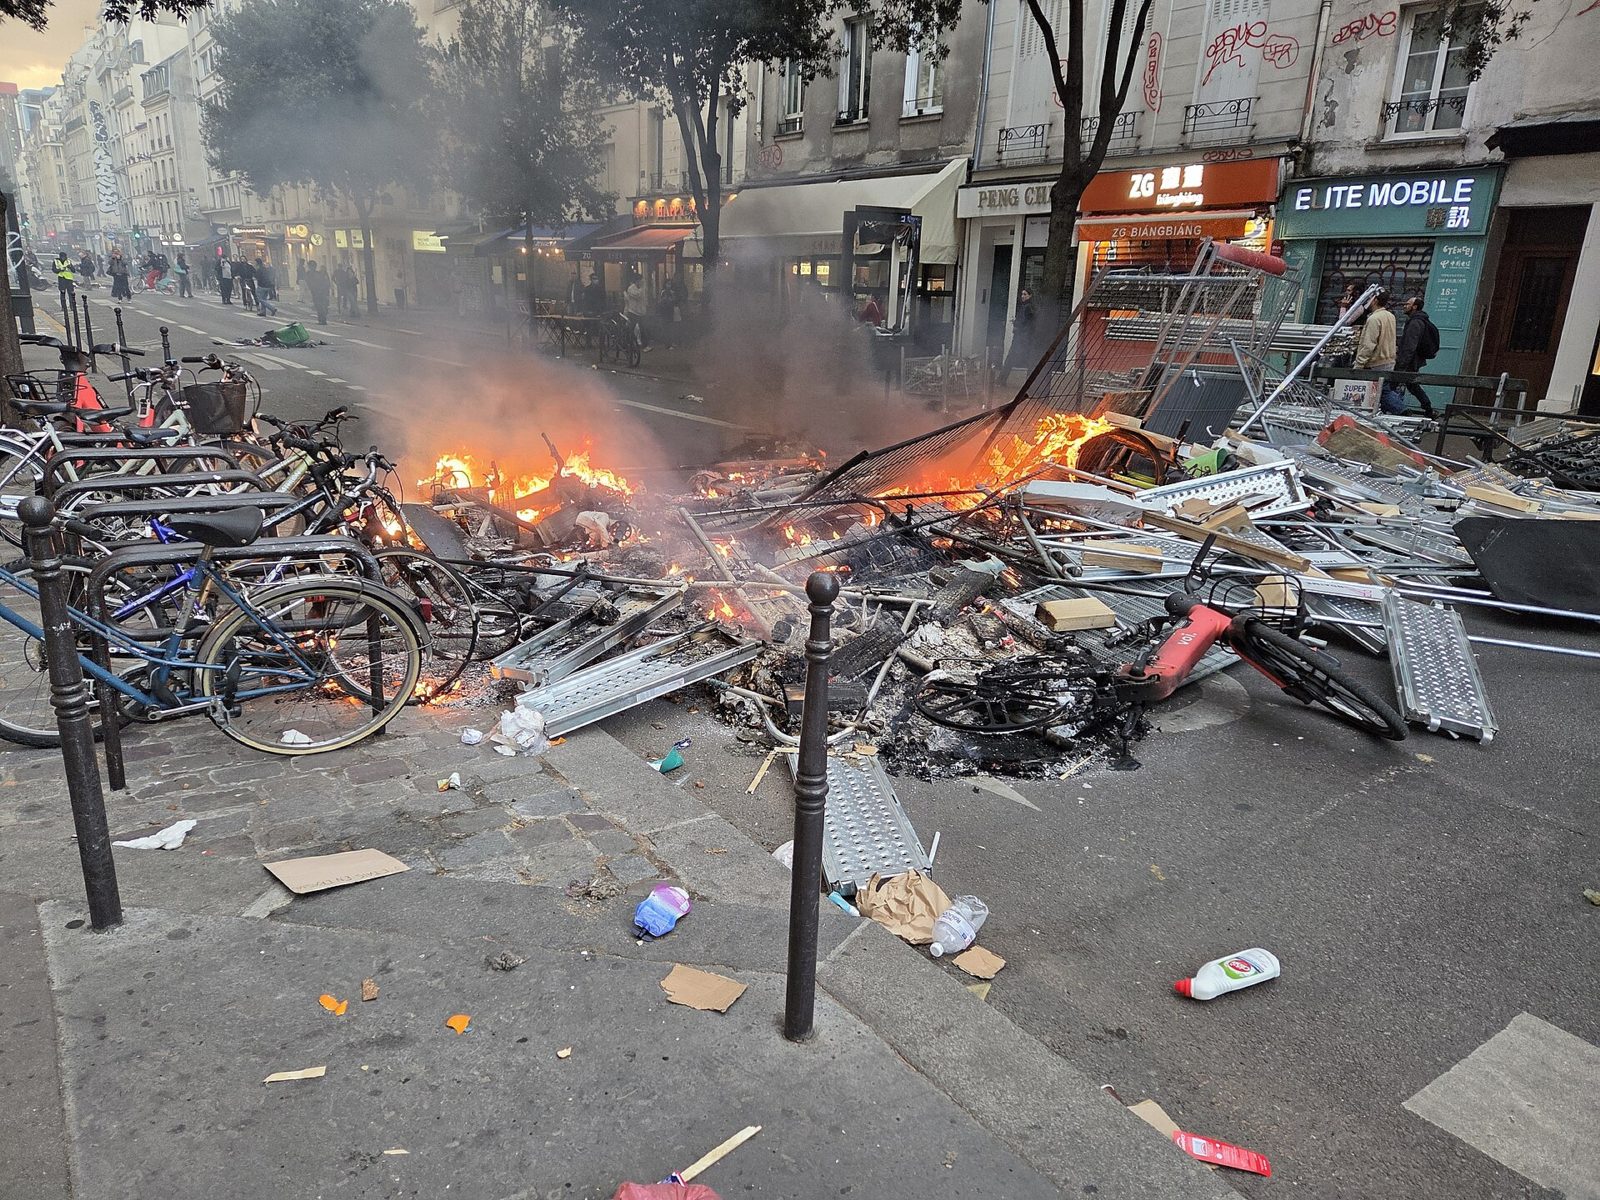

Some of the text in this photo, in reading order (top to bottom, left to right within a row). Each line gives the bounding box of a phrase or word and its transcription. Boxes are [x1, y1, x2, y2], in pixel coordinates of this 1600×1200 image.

[1129, 172, 1155, 199] ZG
[1295, 178, 1475, 210] ELITE MOBILE
[977, 187, 1019, 208] PENG
[657, 204, 685, 217] HAPPY
[1112, 227, 1126, 238] ZG
[1344, 384, 1367, 392] SUPER
